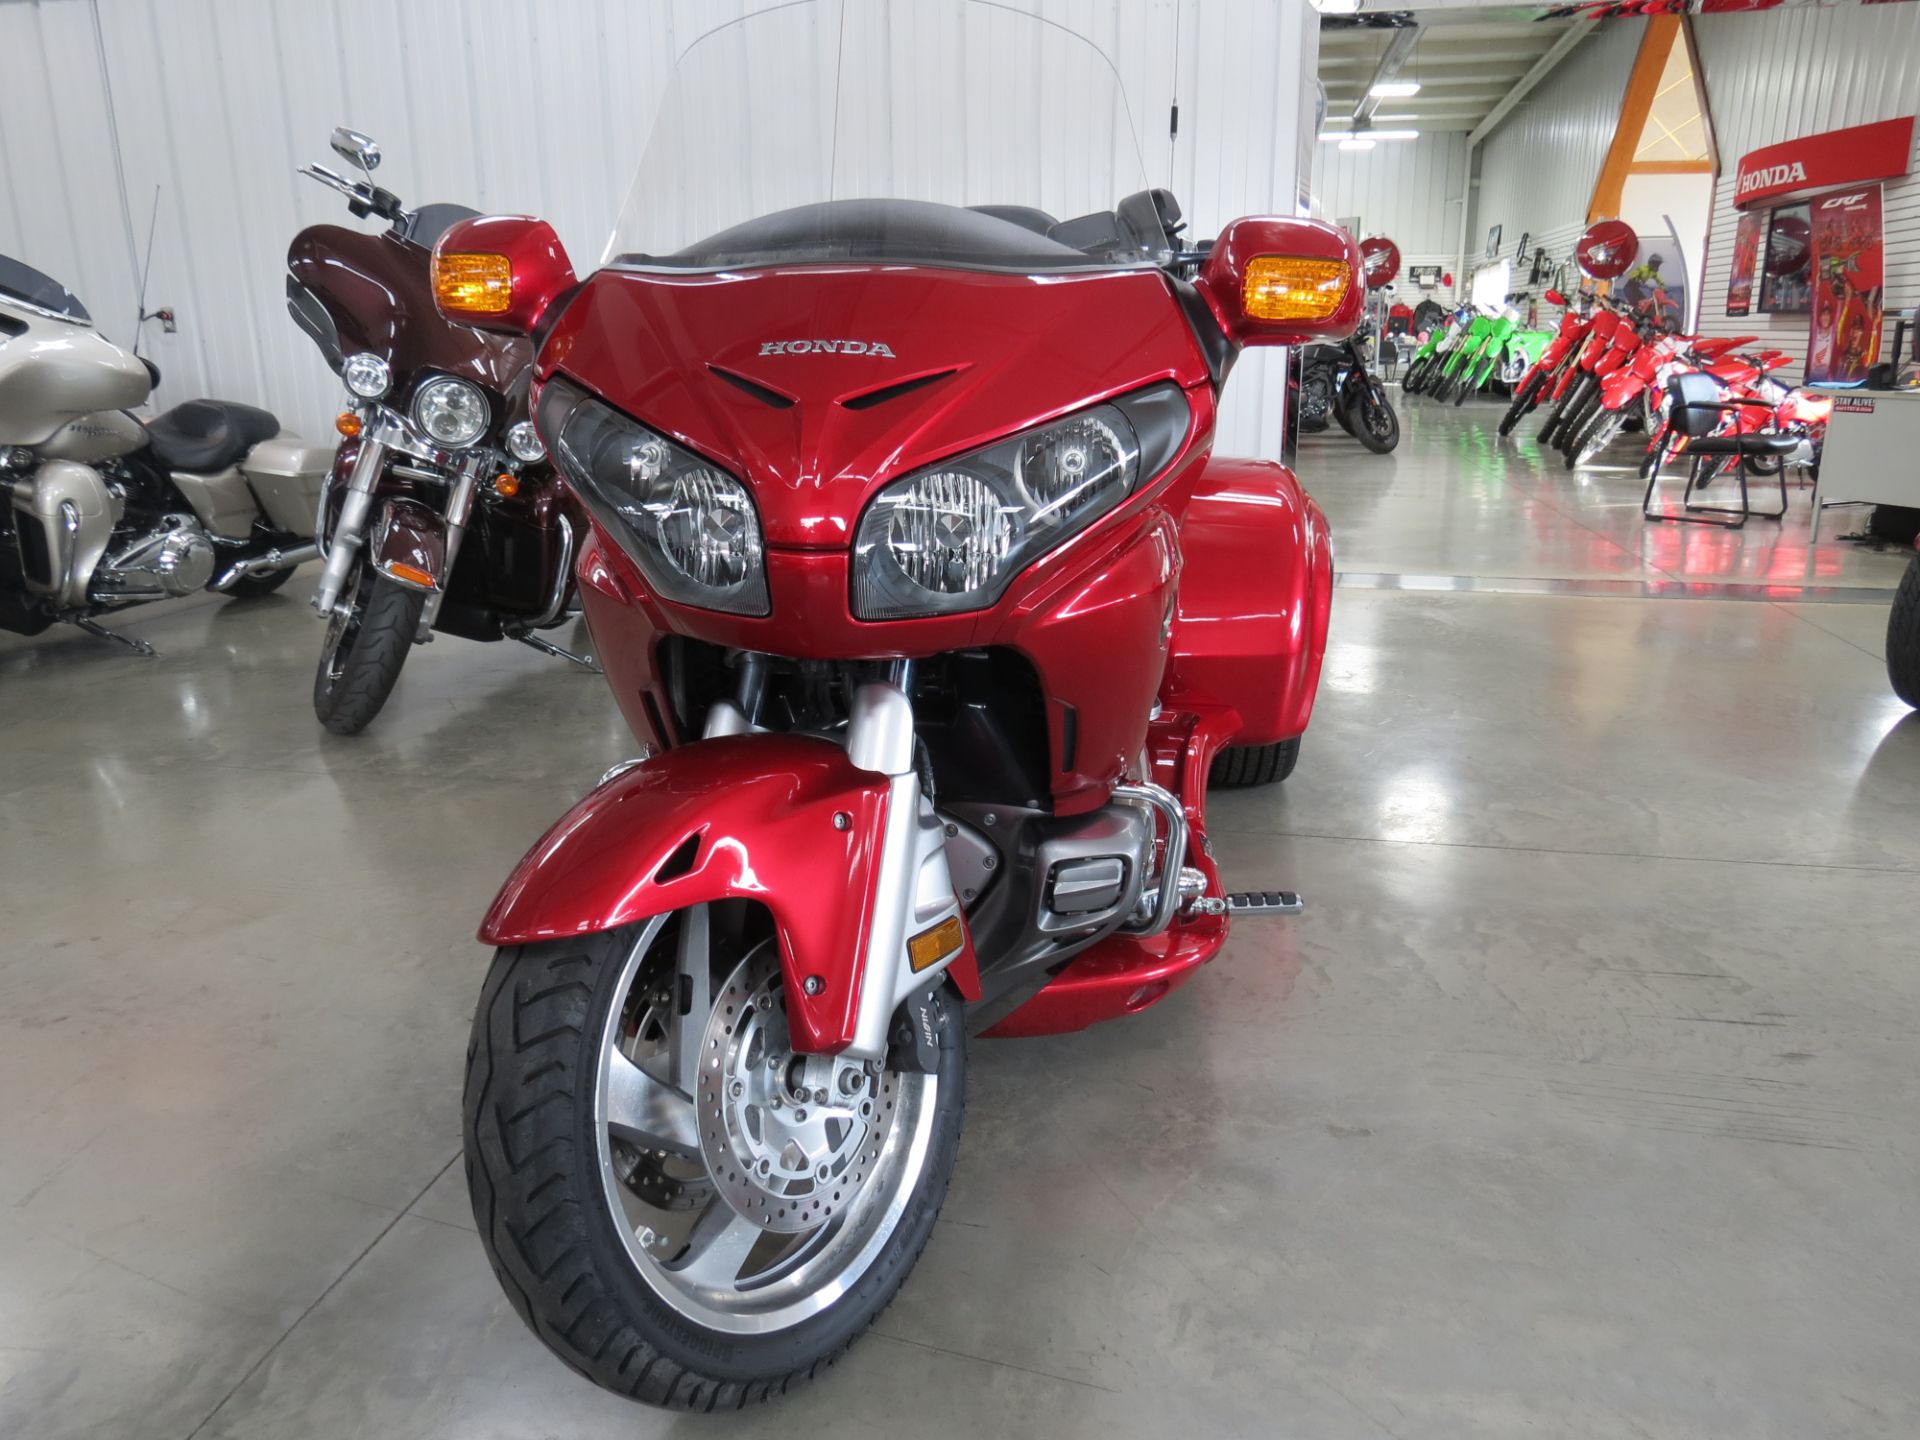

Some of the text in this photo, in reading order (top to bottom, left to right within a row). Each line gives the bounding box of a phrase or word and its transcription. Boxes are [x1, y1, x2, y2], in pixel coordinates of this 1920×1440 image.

[1741, 161, 1807, 194] HONDA
[1821, 193, 1868, 209] CRF
[758, 340, 896, 358] HONDA
[1834, 397, 1853, 406] STAY
